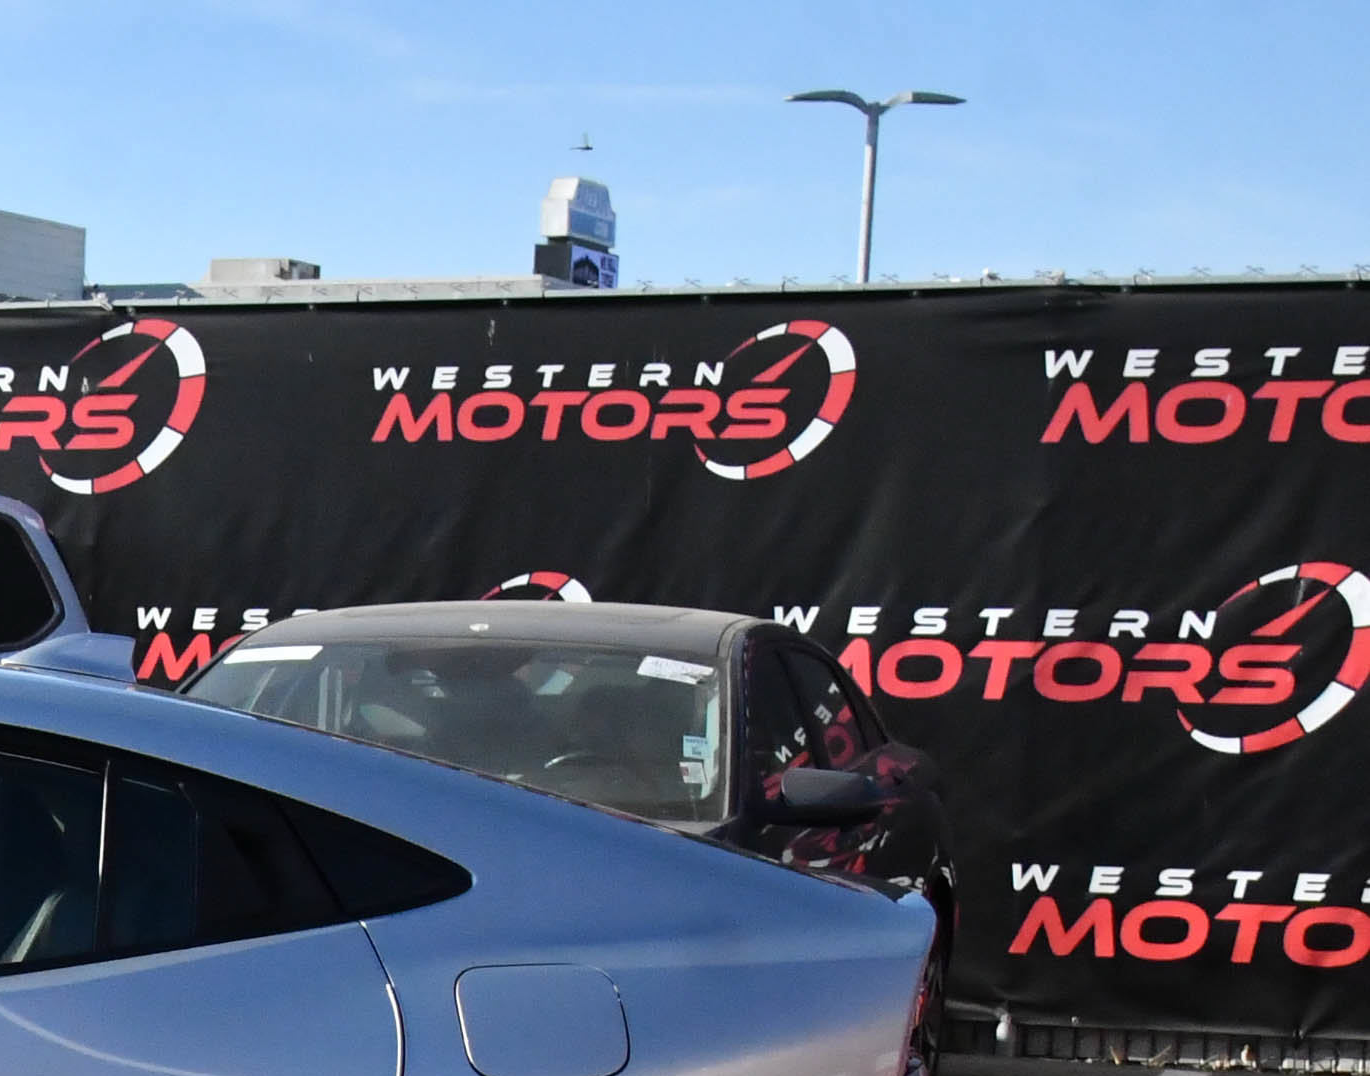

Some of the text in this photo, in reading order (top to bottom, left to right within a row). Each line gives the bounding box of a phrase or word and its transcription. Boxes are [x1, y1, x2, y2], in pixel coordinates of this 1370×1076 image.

[373, 361, 725, 391] WESTERN
[372, 387, 791, 443] MOTORS
[773, 606, 1217, 639] WESTERN
[1011, 863, 1370, 904] WESTE
[1008, 895, 1370, 969] MOTO
